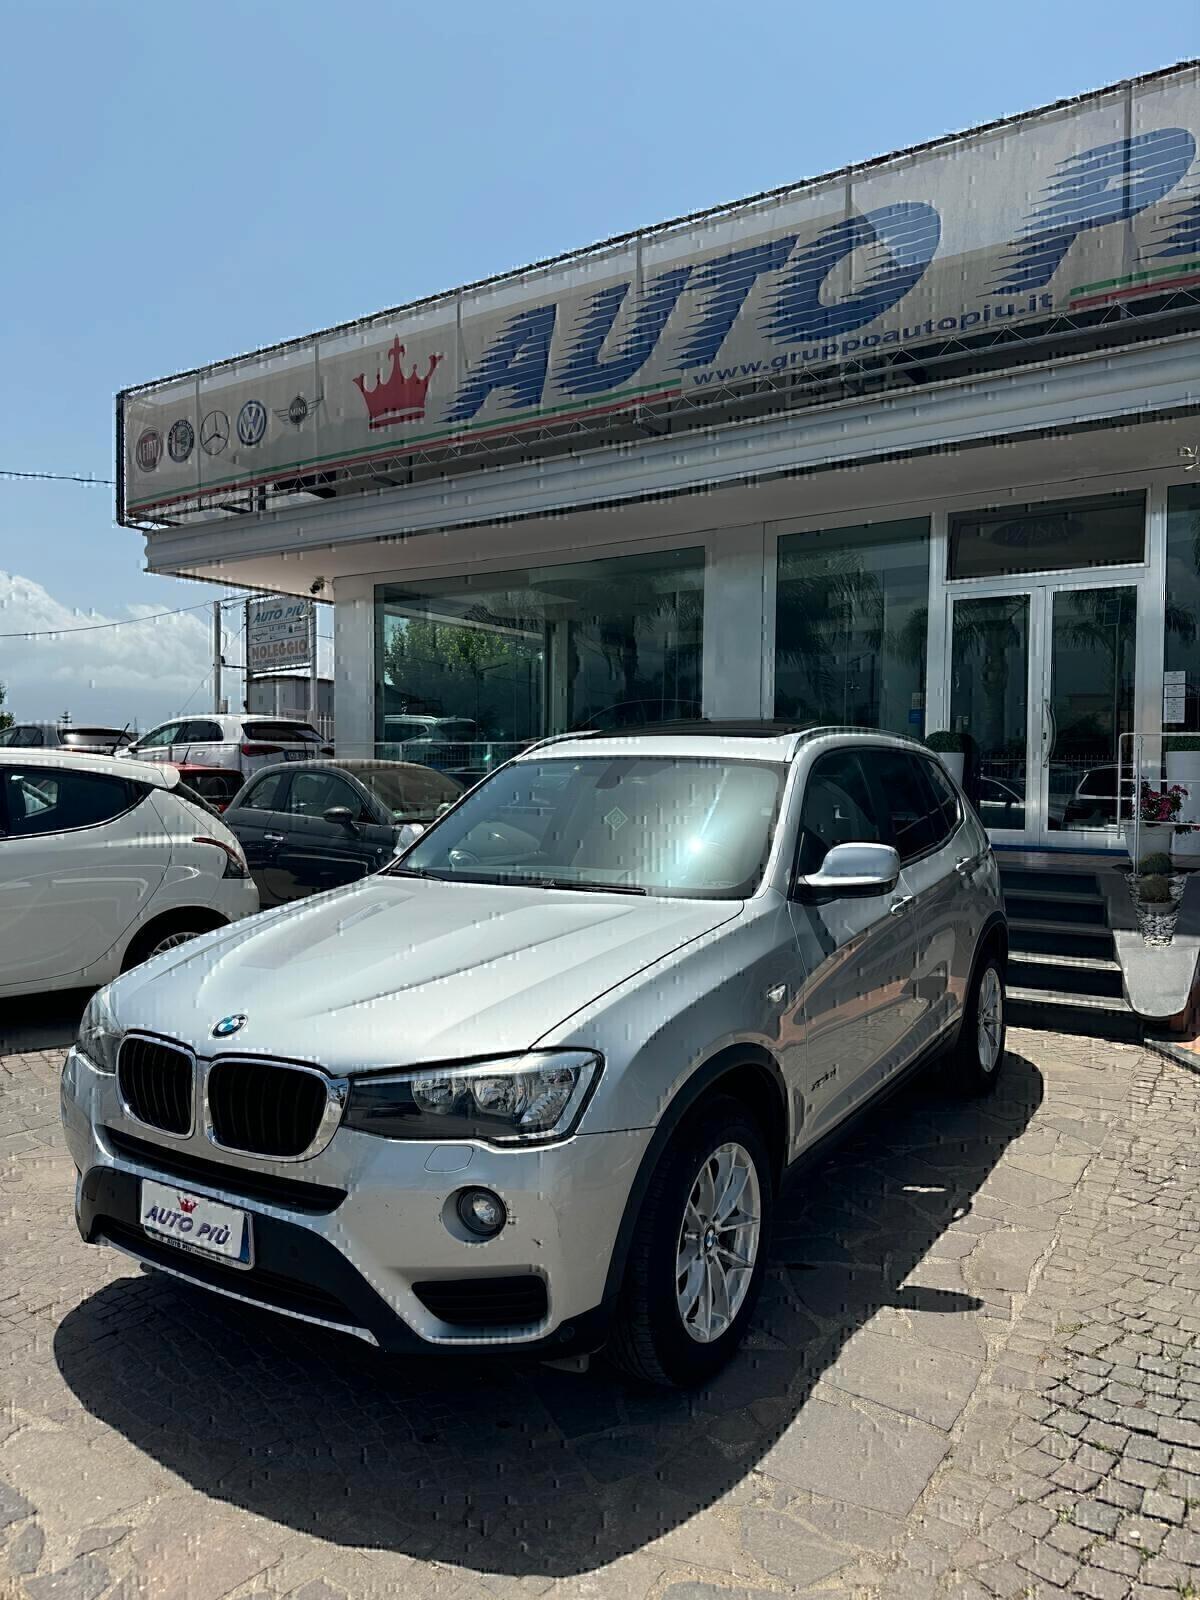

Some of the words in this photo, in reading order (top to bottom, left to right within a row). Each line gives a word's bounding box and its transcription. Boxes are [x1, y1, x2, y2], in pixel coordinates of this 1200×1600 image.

[434, 202, 942, 424] AUTO
[693, 291, 1054, 385] www.gruppoautopiu.it
[289, 405, 306, 417] MINI
[142, 439, 158, 462] FIAT
[253, 608, 283, 624] AUTO
[285, 602, 305, 618] PIÙ
[251, 639, 307, 660] NOLEGGIO
[144, 1205, 194, 1233] AUTO
[196, 1222, 231, 1245] PIÙ
